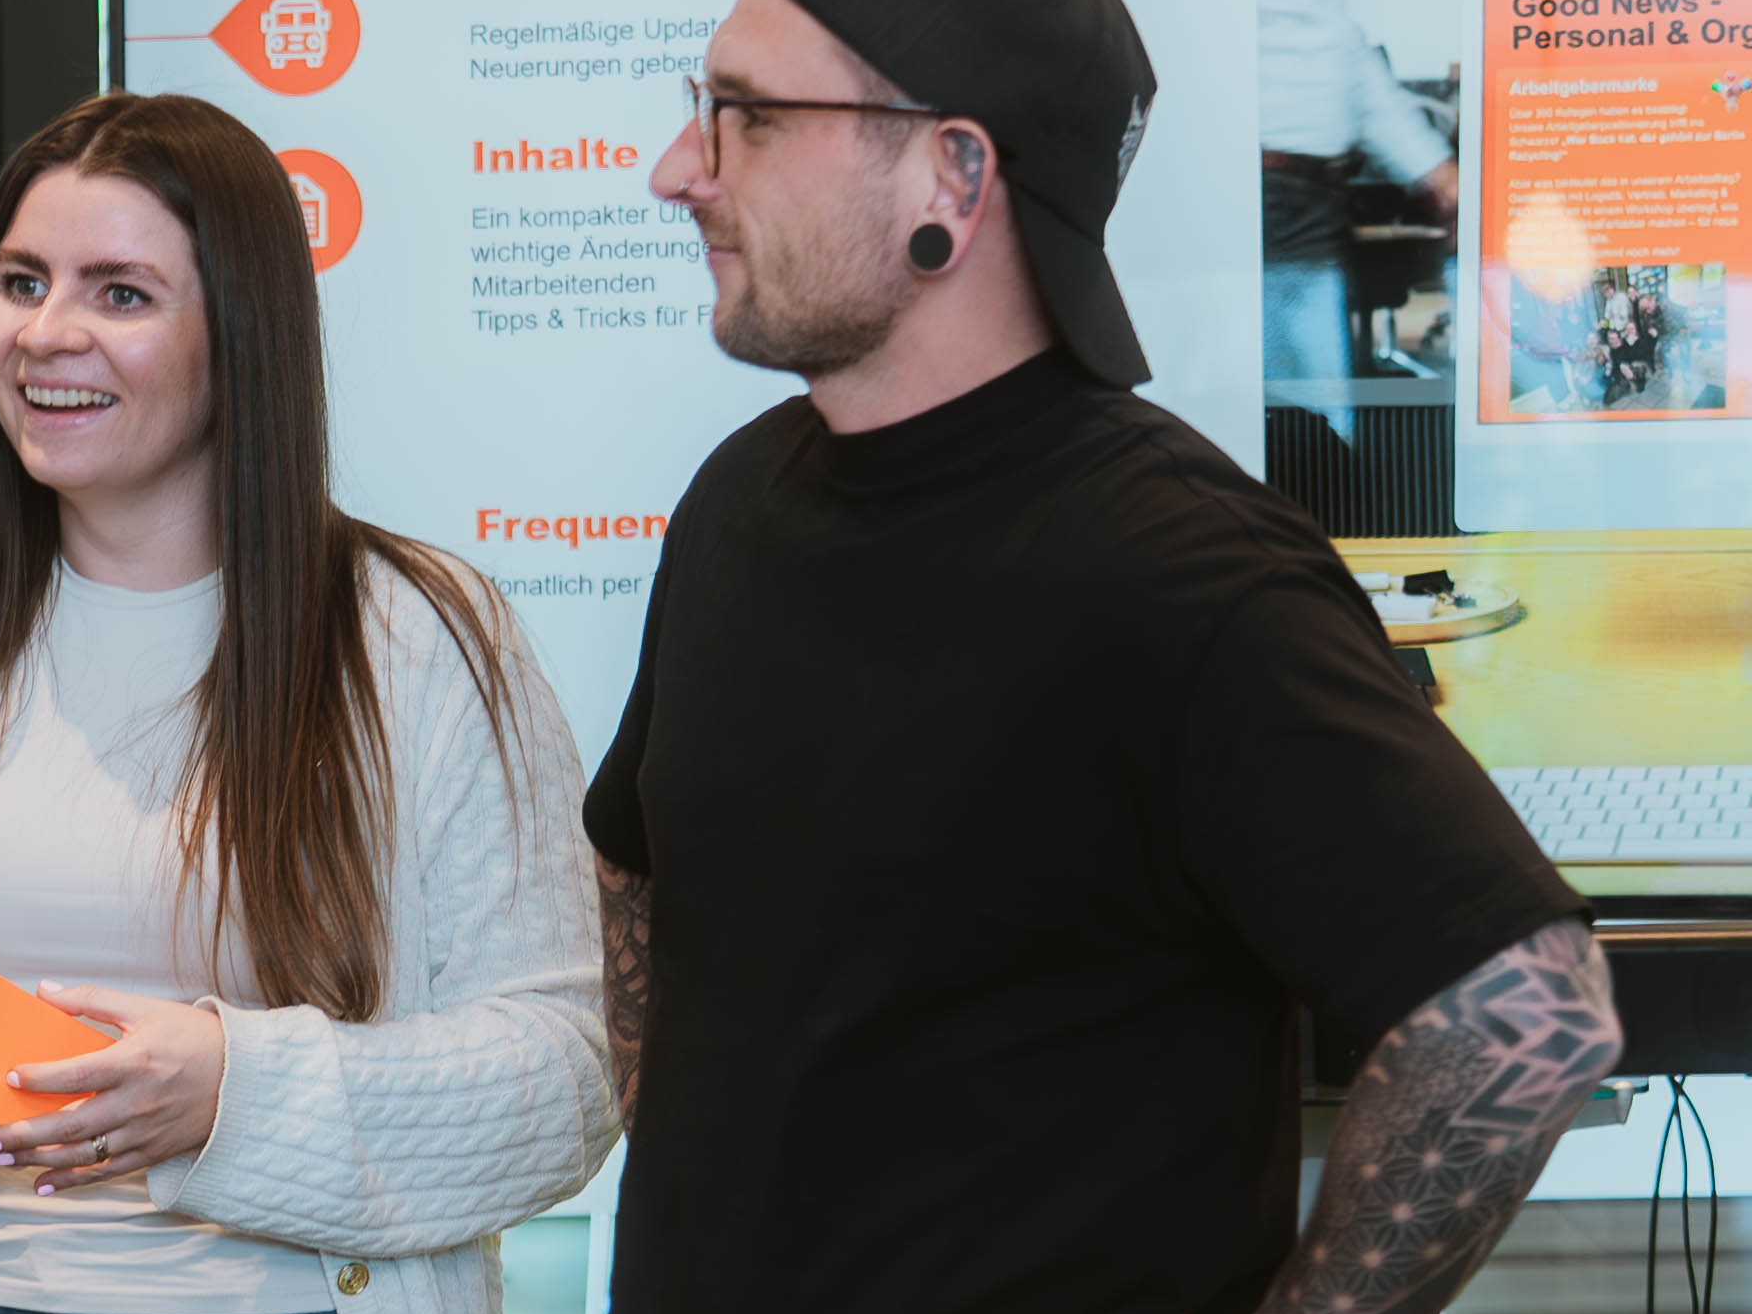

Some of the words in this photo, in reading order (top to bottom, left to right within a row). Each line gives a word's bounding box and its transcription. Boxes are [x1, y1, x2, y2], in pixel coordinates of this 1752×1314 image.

[470, 20, 634, 50] Regelmäßige
[1513, 22, 1654, 51] Personal
[1666, 20, 1690, 45] &
[470, 56, 622, 83] Neuerungen
[1509, 77, 1659, 97] Arbeitgebermarke
[472, 137, 639, 174] Inhalte
[472, 207, 510, 230] Ein
[519, 204, 648, 233] kompakter
[471, 241, 571, 268] wichtige
[472, 272, 656, 299] Mitarbeitenden
[472, 308, 538, 335] Tipps
[547, 309, 564, 329] &
[574, 306, 646, 329] Tricks
[656, 304, 688, 326] für
[492, 573, 593, 597] onatlich
[602, 575, 642, 601] per
